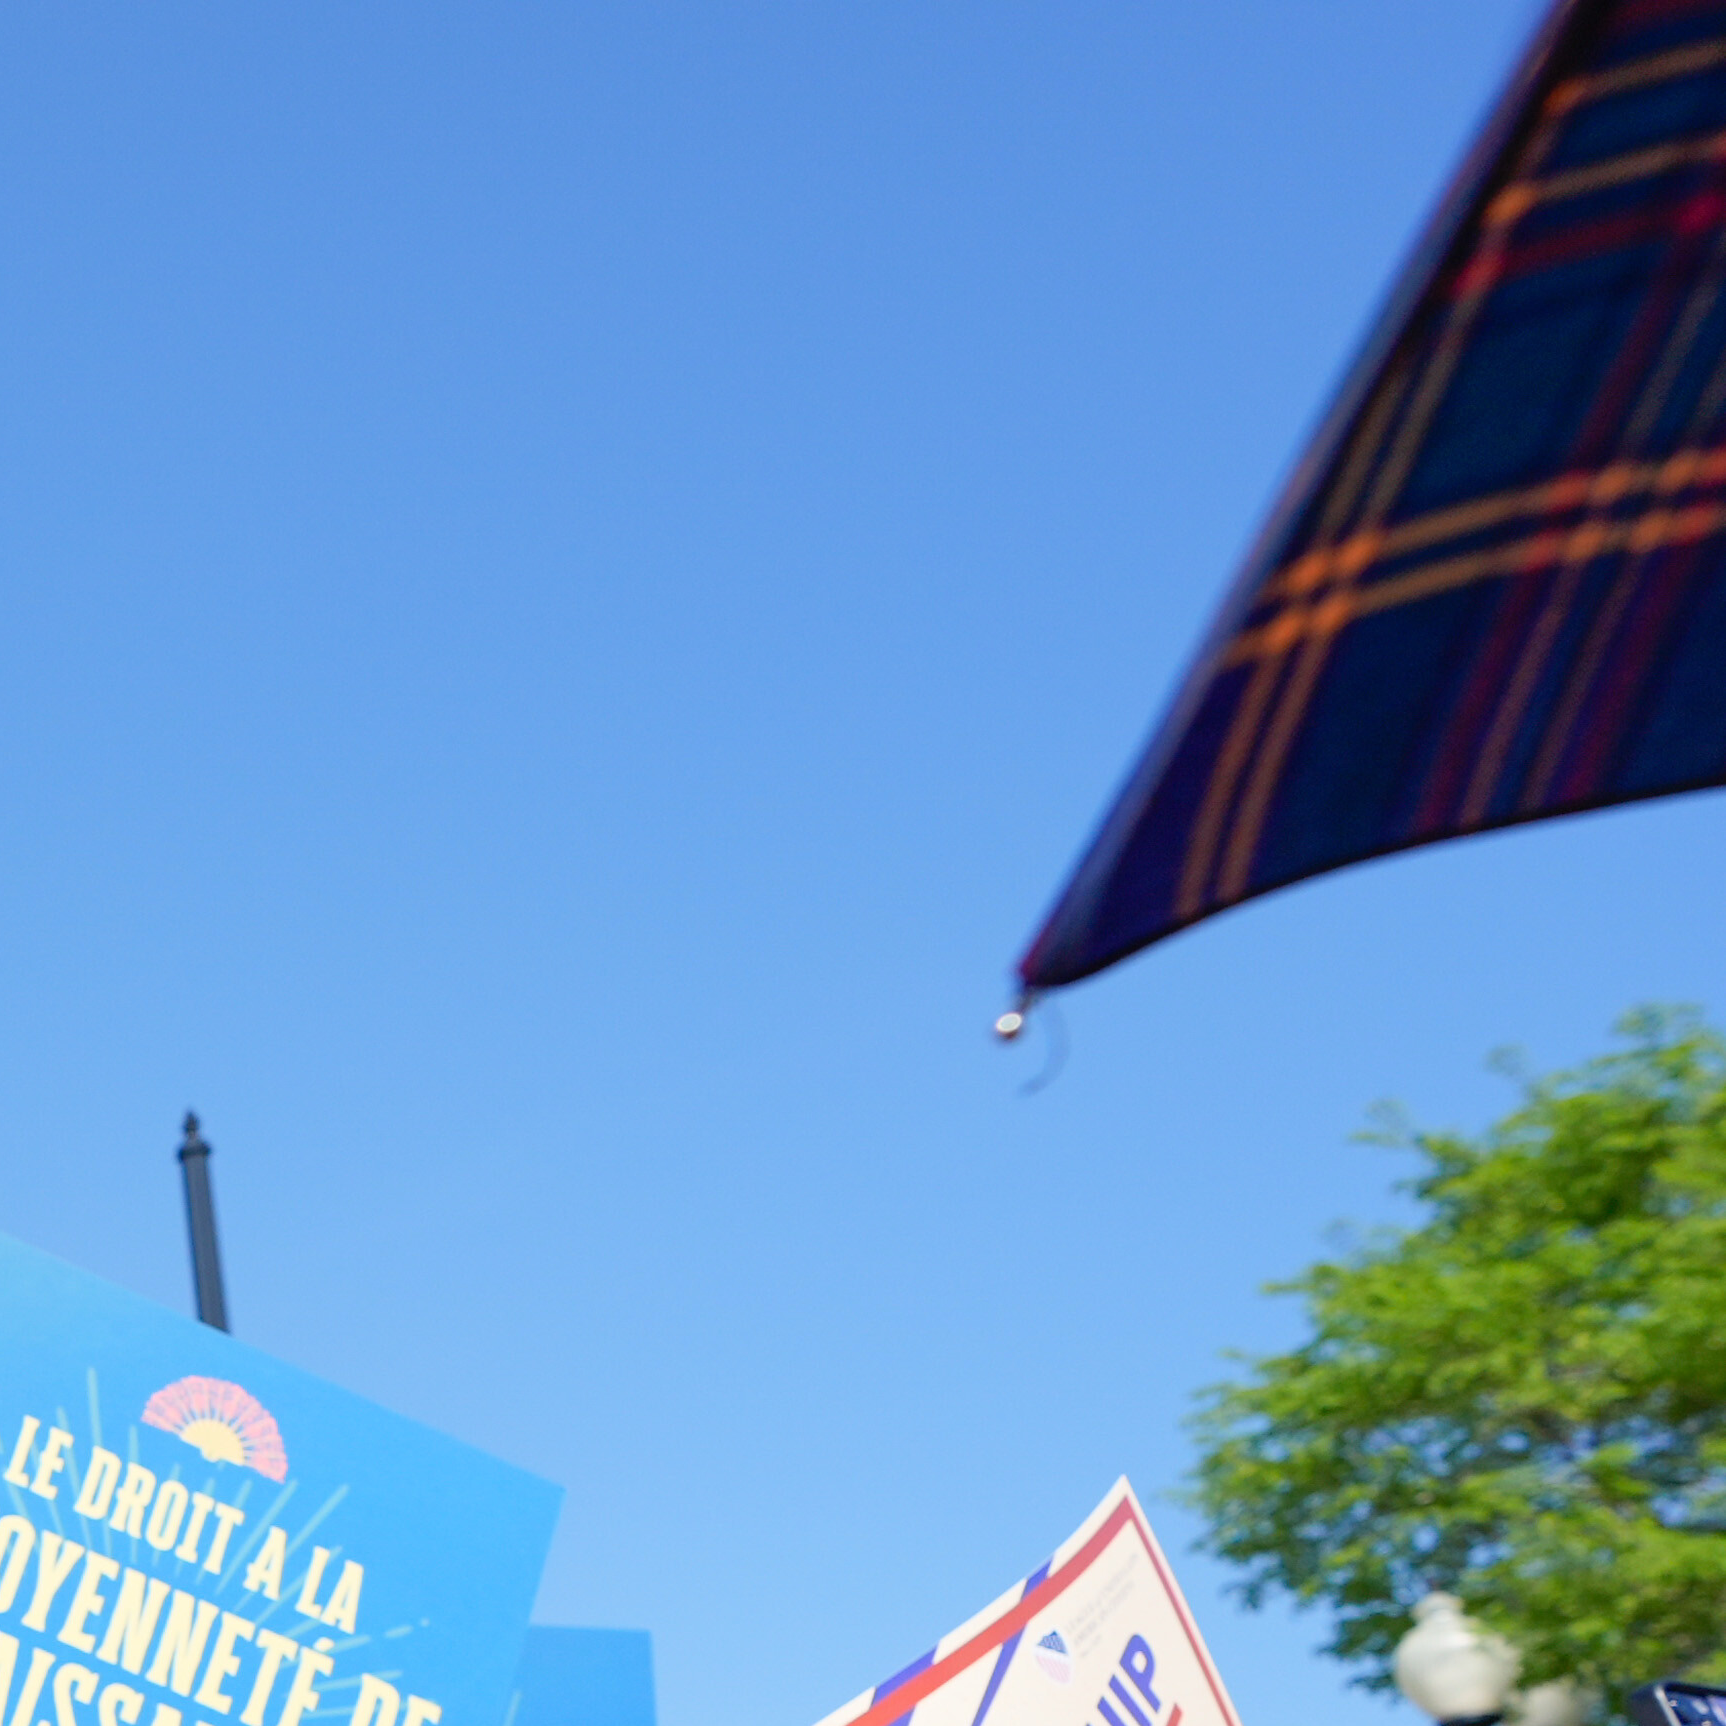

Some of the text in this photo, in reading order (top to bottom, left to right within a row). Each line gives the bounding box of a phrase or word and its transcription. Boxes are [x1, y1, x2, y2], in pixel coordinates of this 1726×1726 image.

[4, 1416, 365, 1634] LE DROIT A LA
